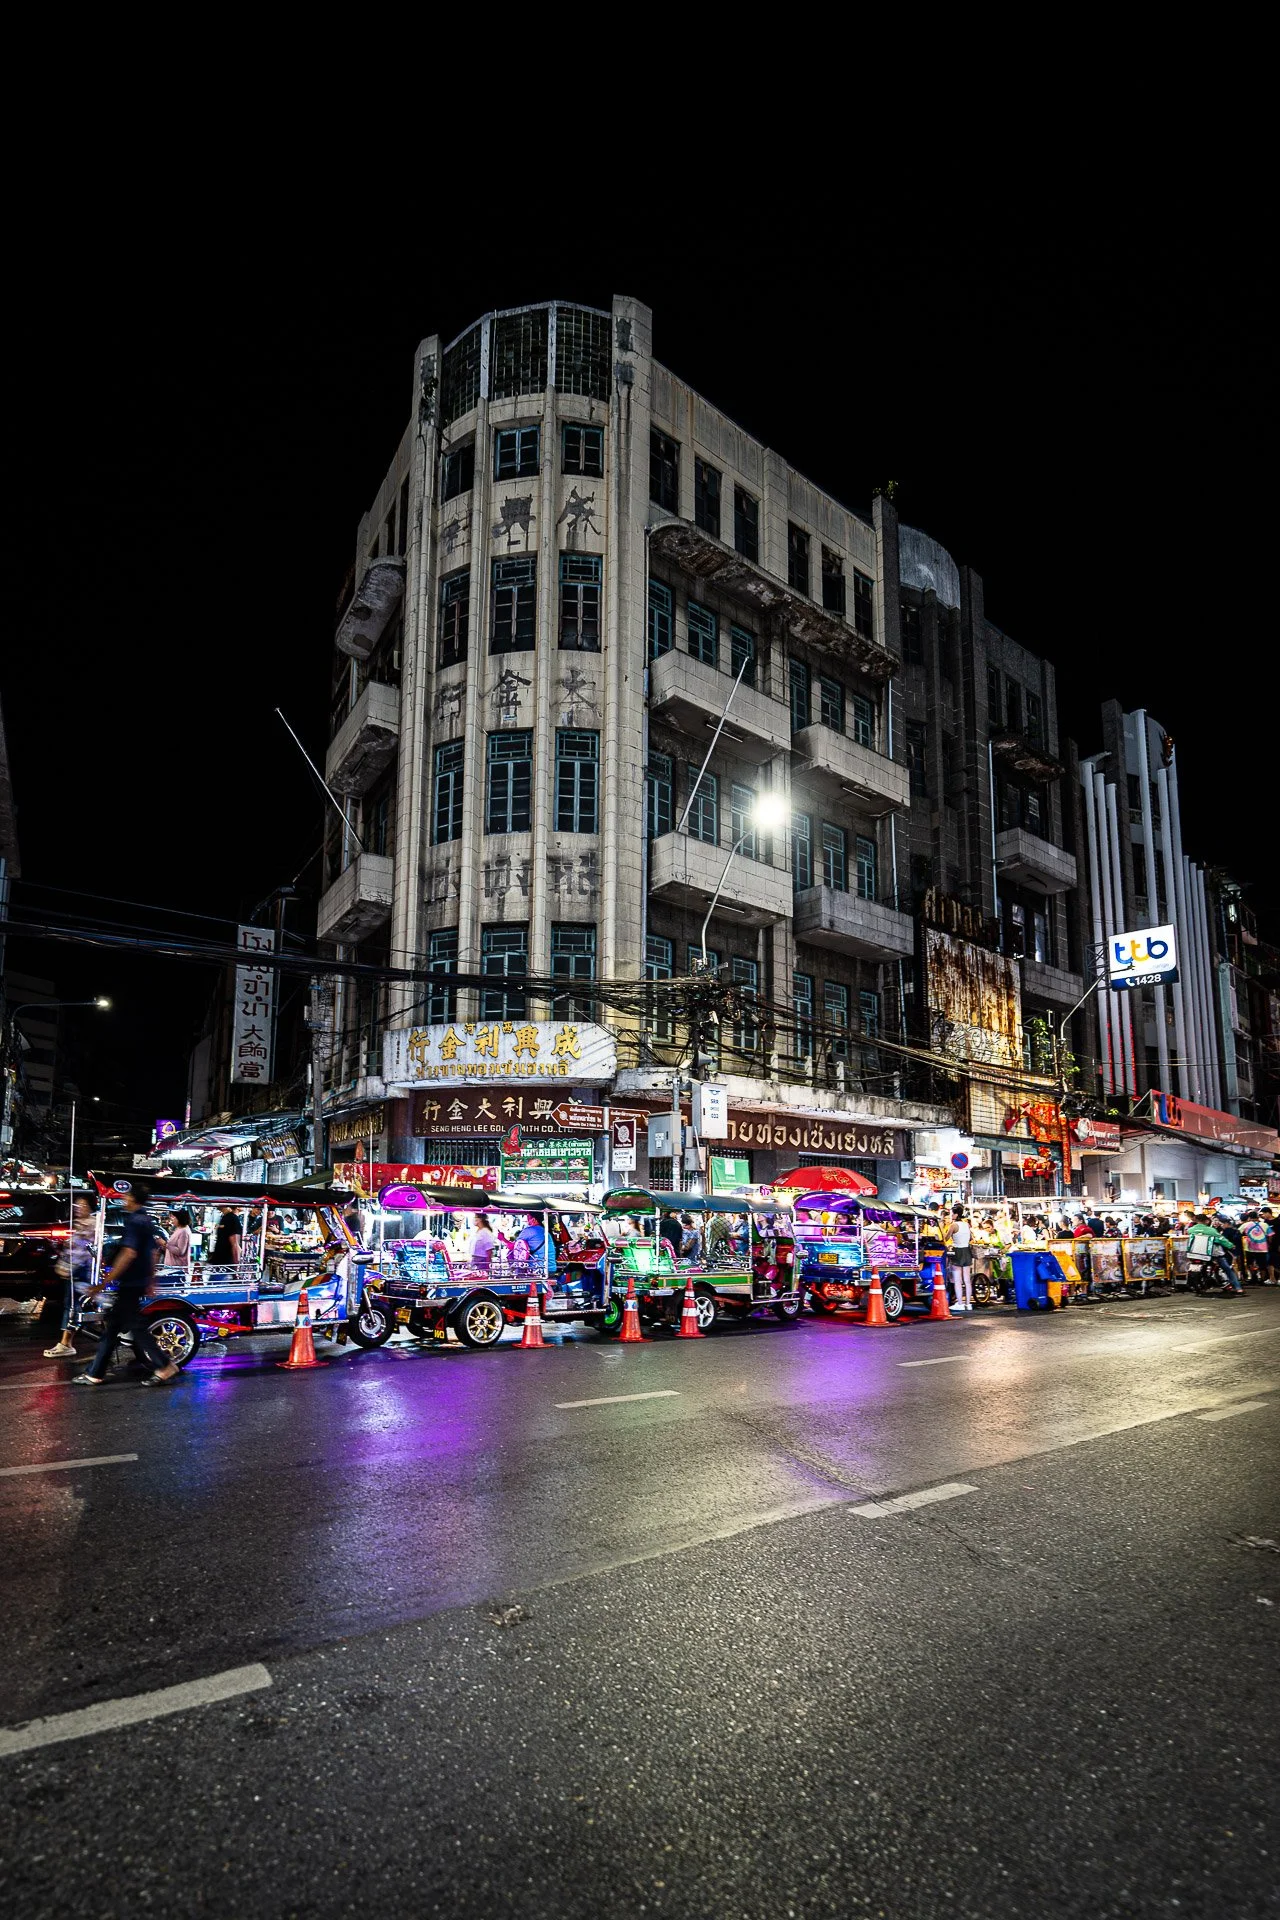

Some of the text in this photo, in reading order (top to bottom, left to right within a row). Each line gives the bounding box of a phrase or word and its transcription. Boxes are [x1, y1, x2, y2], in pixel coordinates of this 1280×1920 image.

[1114, 937, 1169, 965] ttb
[1134, 974, 1162, 986] 1428
[431, 1125, 450, 1133] SENG
[473, 1124, 488, 1132] LEE
[490, 1124, 540, 1133] GOLMITH
